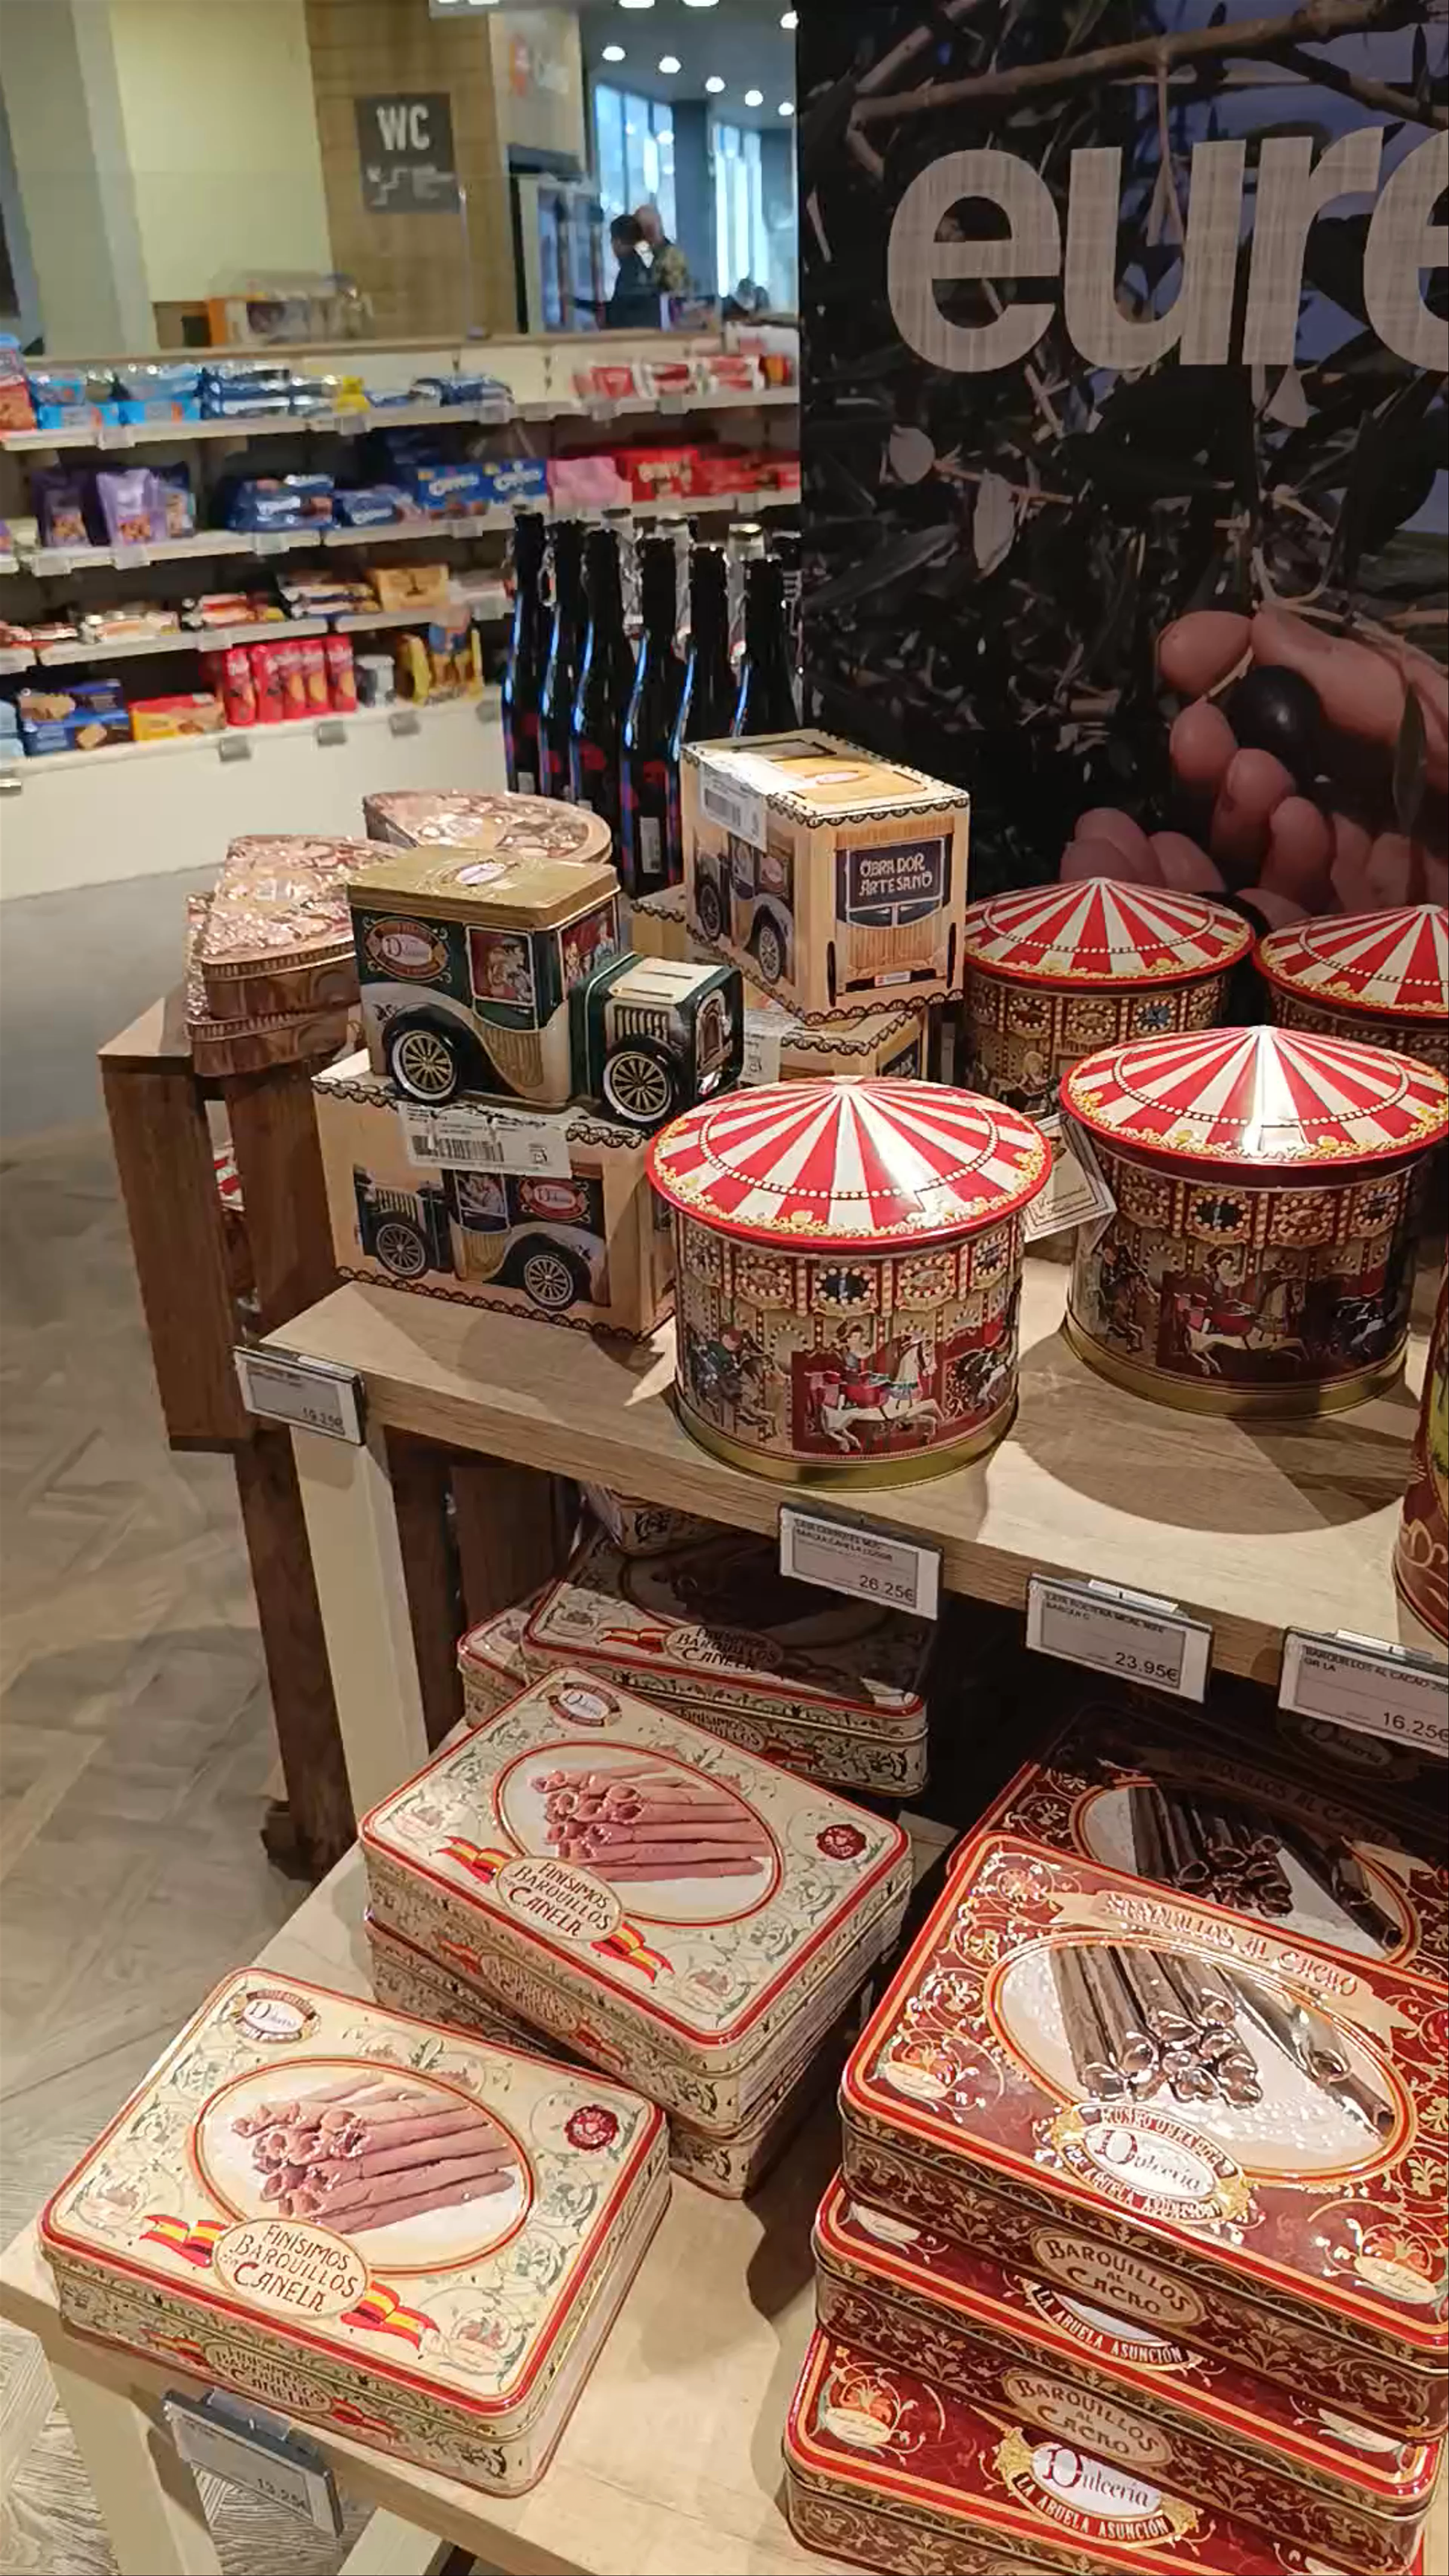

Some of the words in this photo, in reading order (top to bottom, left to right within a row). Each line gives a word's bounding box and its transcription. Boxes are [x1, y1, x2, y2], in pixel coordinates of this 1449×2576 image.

[376, 104, 429, 151] WC
[859, 871, 932, 896] ARTESANO
[860, 853, 925, 877] OBRADOR
[1116, 1652, 1179, 1682] 23.95€
[1384, 1712, 1449, 1743] 16.25€
[509, 1887, 582, 1936] CANELA
[510, 1866, 612, 1930] BARQUILLOS
[1240, 1936, 1269, 1961] AL
[1277, 1950, 1358, 1996] CACAO
[1095, 2129, 1200, 2192] Dulcería
[229, 2234, 358, 2298] BARQUILLOS
[263, 2224, 351, 2270] FINÍSIMOS
[234, 2262, 326, 2312] CANELA
[1044, 2240, 1191, 2311] BARQUILLOS
[1067, 2267, 1160, 2315] CACAO
[1106, 2272, 1124, 2284] AL
[1037, 2290, 1055, 2309] LA
[1052, 2310, 1104, 2350] ABUELA
[1110, 2341, 1183, 2365] ASUNCIÓN
[1017, 2379, 1160, 2452] BARQUILLOS
[1037, 2405, 1129, 2454] CACAO
[1075, 2411, 1094, 2424] AL
[1043, 2448, 1148, 2507] Dulcería
[1017, 2475, 1036, 2498] LA
[1036, 2496, 1089, 2533] ABUELA
[1098, 2517, 1169, 2539] ASUNCIÓN
